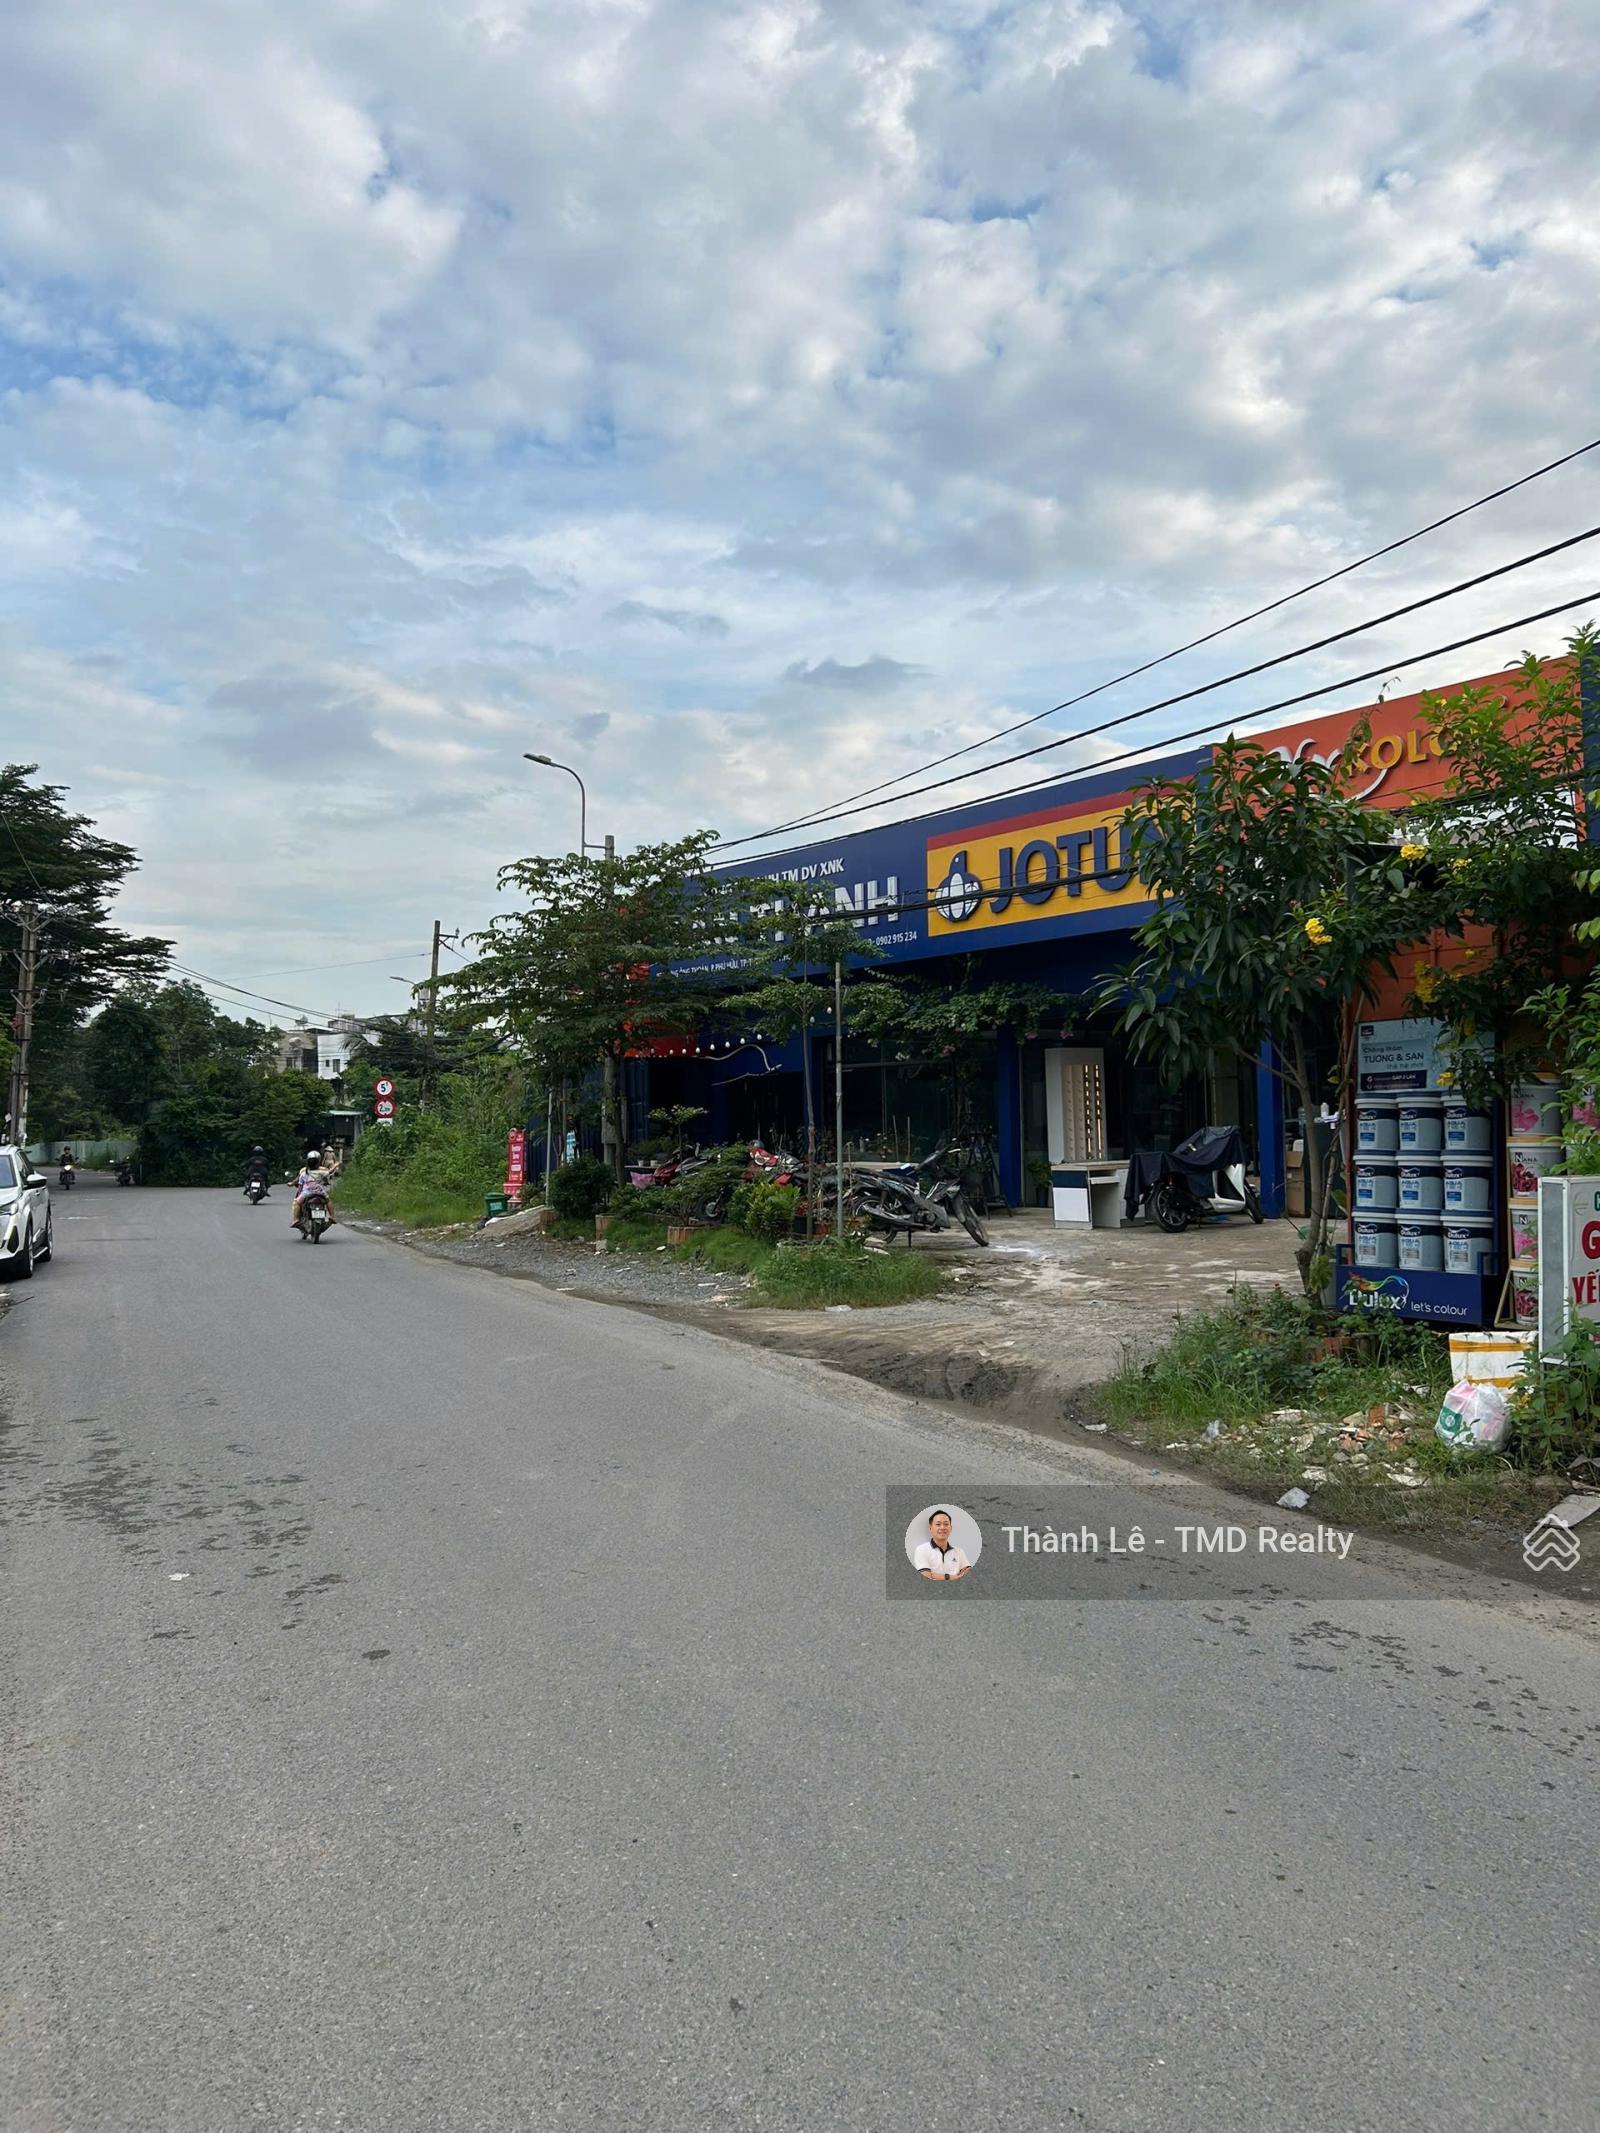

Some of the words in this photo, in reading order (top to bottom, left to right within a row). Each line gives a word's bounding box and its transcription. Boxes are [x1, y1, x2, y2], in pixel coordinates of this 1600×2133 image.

[781, 868, 798, 881] TM
[801, 864, 818, 880] DV
[819, 858, 845, 876] XNK
[875, 935, 892, 946] 0902
[892, 933, 904, 944] 915
[904, 931, 917, 941] 234
[1411, 1301, 1432, 1313] let's
[1433, 1304, 1468, 1316] colour
